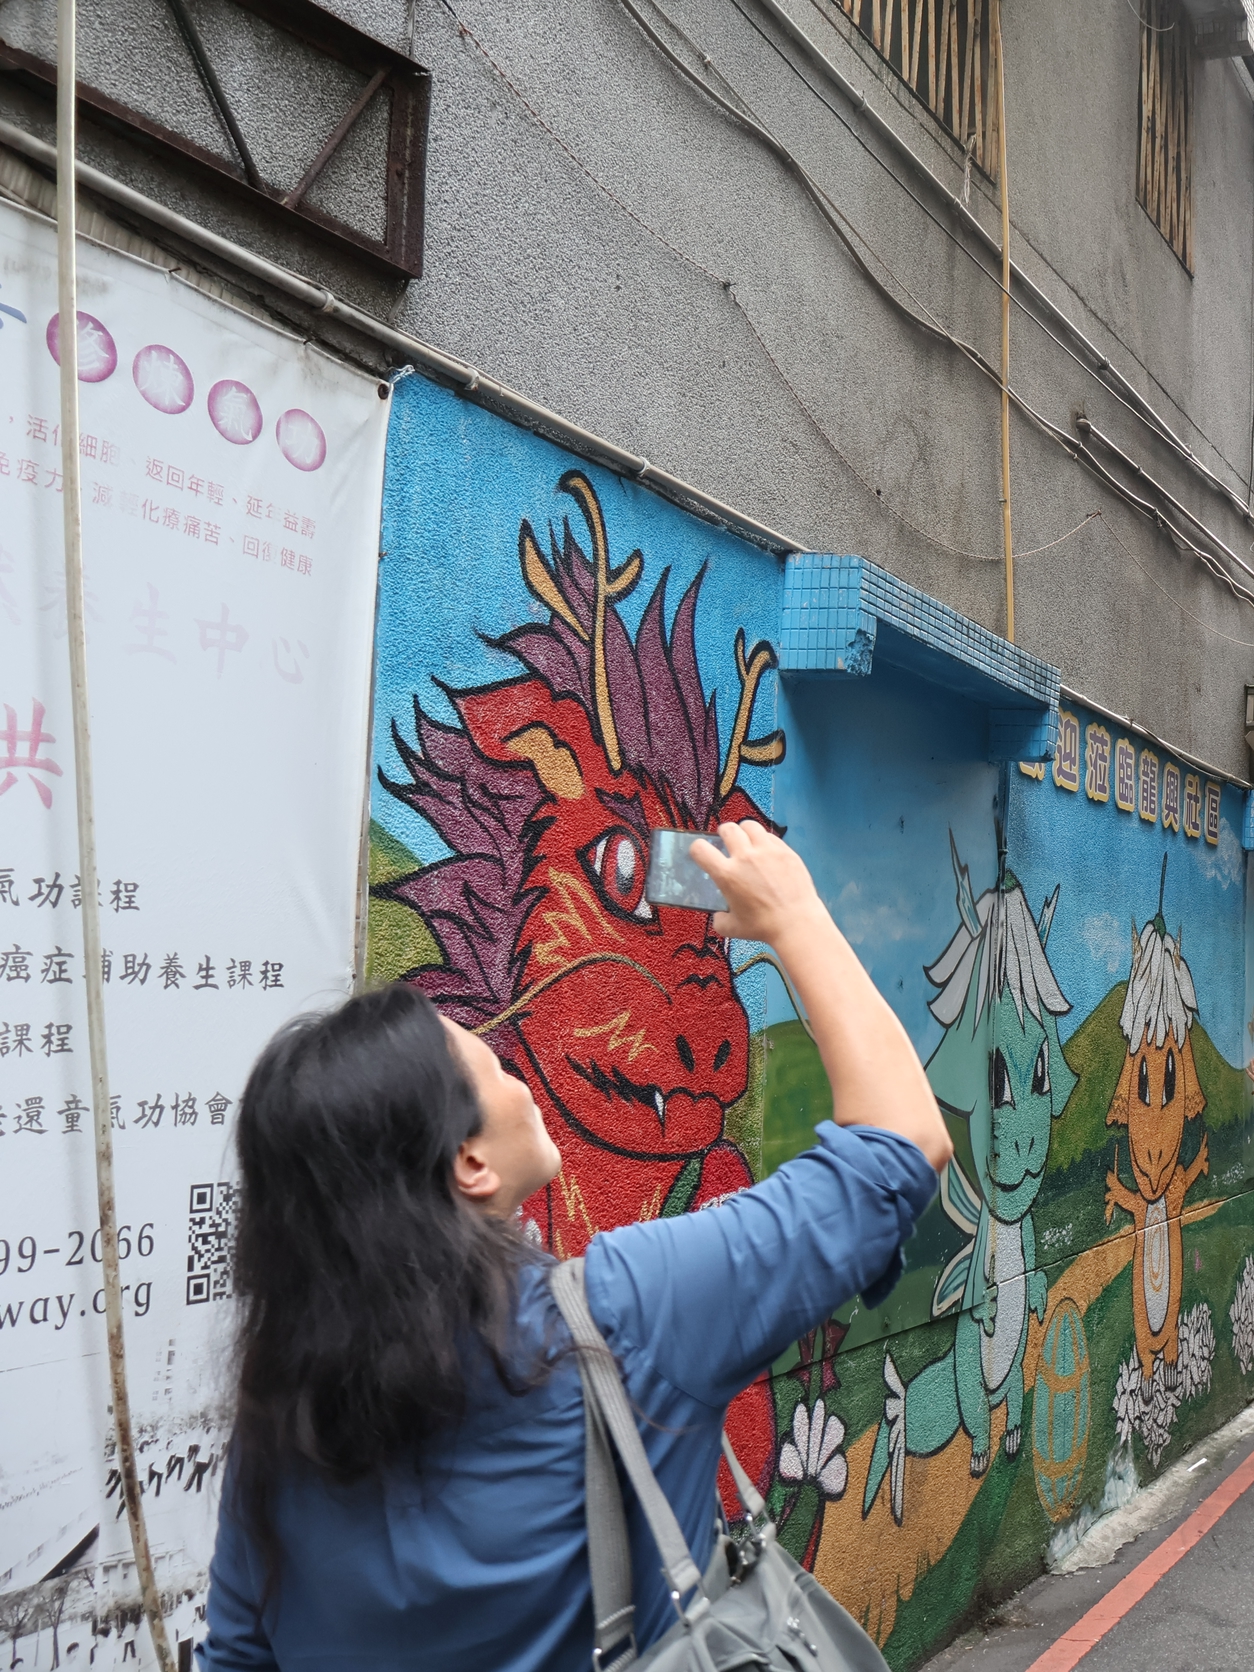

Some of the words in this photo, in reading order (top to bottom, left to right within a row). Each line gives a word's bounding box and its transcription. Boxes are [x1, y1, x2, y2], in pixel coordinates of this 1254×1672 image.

[1021, 715, 1221, 842] 迎蒞臨龍興社區
[0, 1090, 234, 1138] 還童氣功協會
